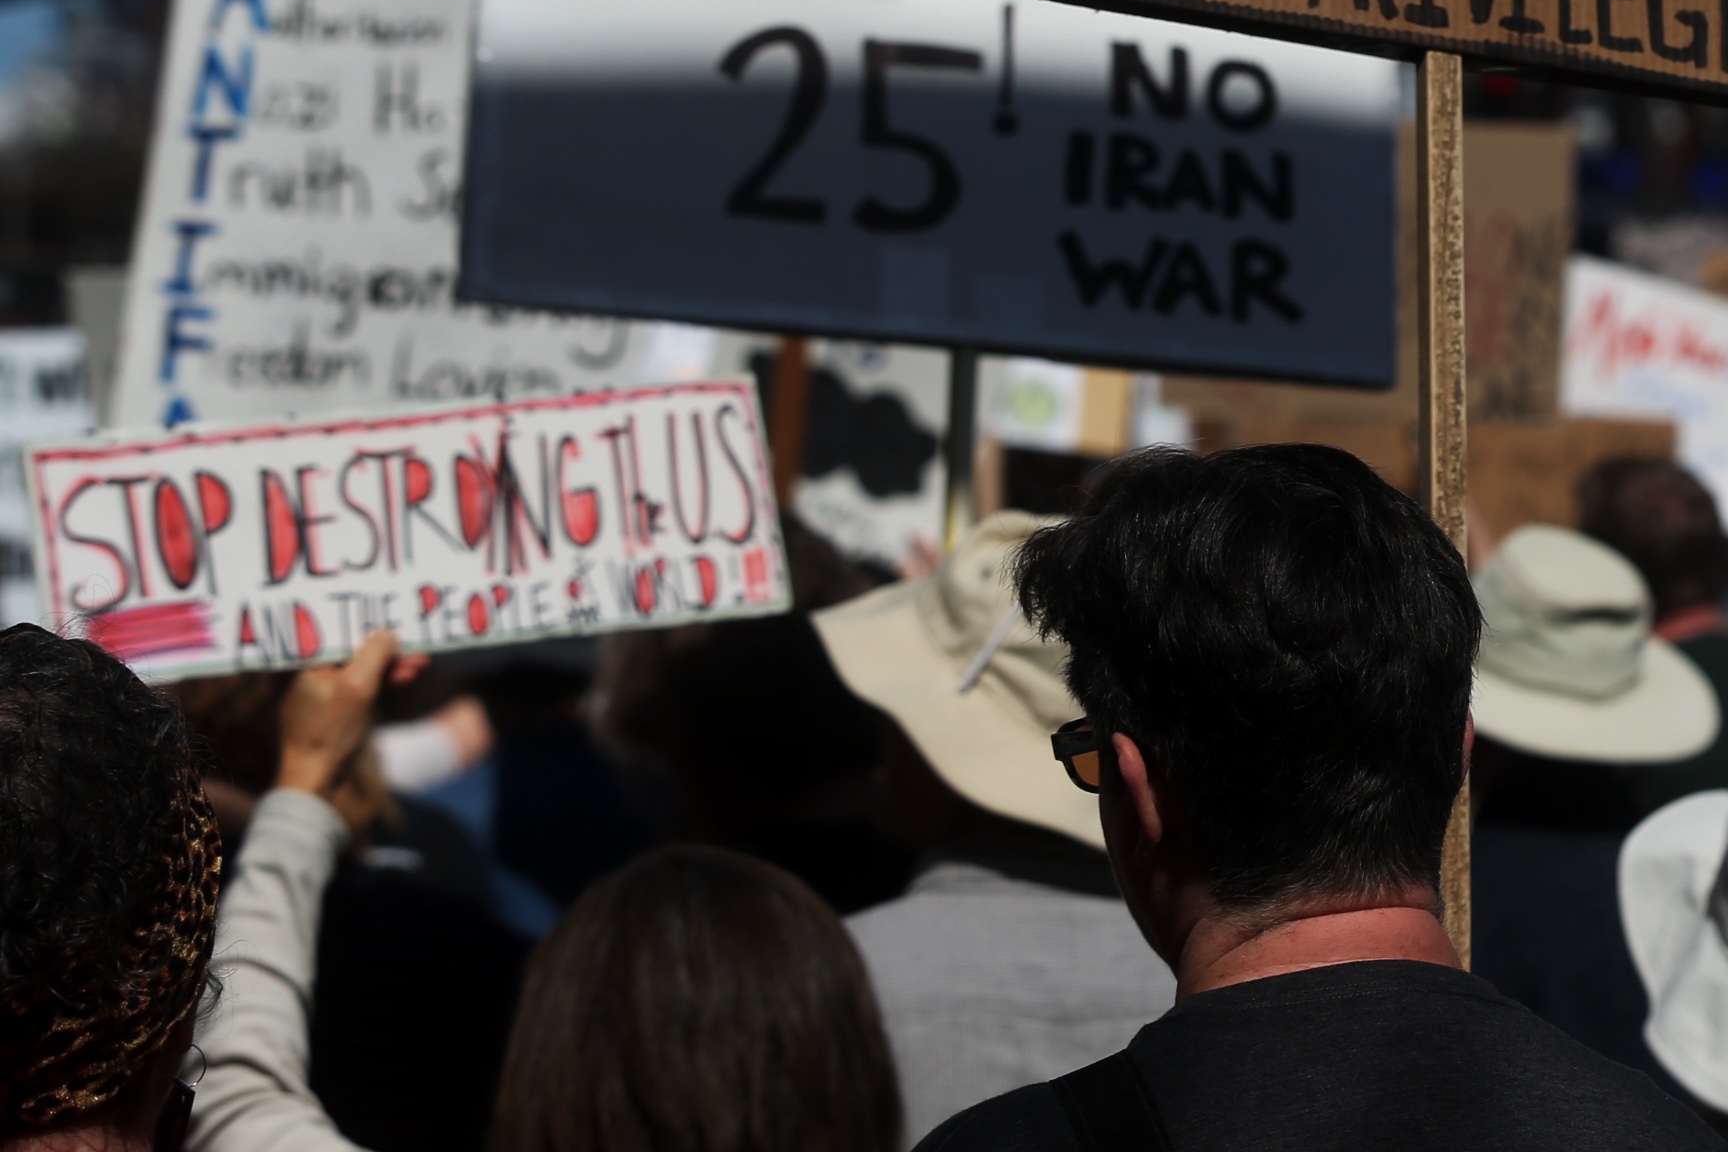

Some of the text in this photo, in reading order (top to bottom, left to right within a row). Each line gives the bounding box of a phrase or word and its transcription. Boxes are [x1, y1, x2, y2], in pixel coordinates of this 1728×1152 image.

[1109, 40, 1277, 132] NO
[1065, 130, 1294, 223] IRAN
[1058, 230, 1304, 325] WAR
[60, 470, 233, 616] STOP
[666, 404, 757, 543] US
[236, 598, 321, 664] AND
